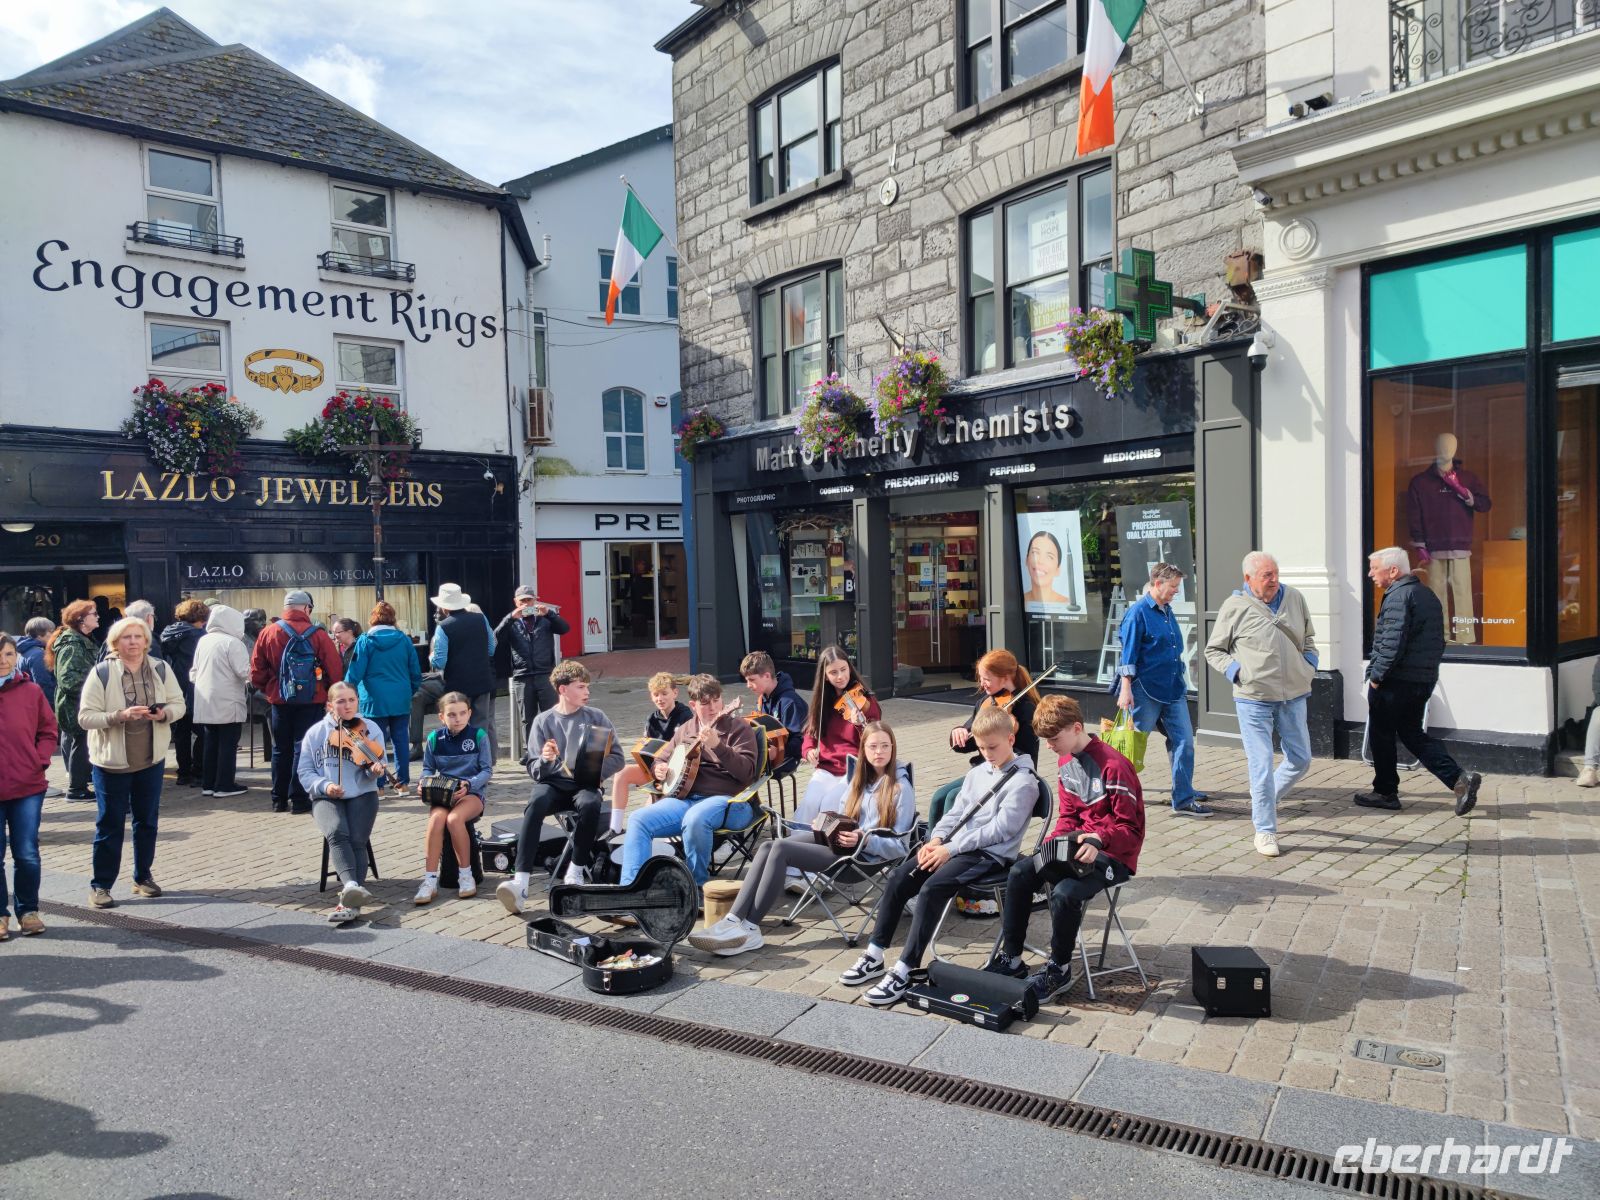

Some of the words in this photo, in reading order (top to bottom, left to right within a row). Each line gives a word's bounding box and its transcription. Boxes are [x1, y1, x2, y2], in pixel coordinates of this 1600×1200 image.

[32, 239, 378, 324] Engagement
[391, 291, 498, 348] Rings
[756, 443, 795, 471] Matt
[937, 400, 1069, 445] Chemists
[1103, 448, 1161, 464] MEDICINES
[989, 463, 1036, 477] PERFUMES
[100, 470, 236, 503] LAZLO
[884, 471, 960, 489] PRESCRIPTIONS
[819, 485, 855, 495] COSMETICS
[736, 492, 776, 504] PHOTOGRAPHIC
[595, 513, 680, 531] PRE
[1131, 520, 1174, 530] PROFESSIONAL
[35, 534, 61, 547] 20
[1126, 531, 1141, 540] ORAL
[1141, 530, 1157, 539] CARE
[1157, 529, 1163, 538] AT
[1164, 528, 1182, 537] HOME
[188, 565, 244, 578] LAZLO
[260, 570, 328, 582] DIAMOND
[333, 569, 399, 580] SPECIAST
[1452, 616, 1479, 625] Ralph
[1481, 616, 1515, 624] Lauren
